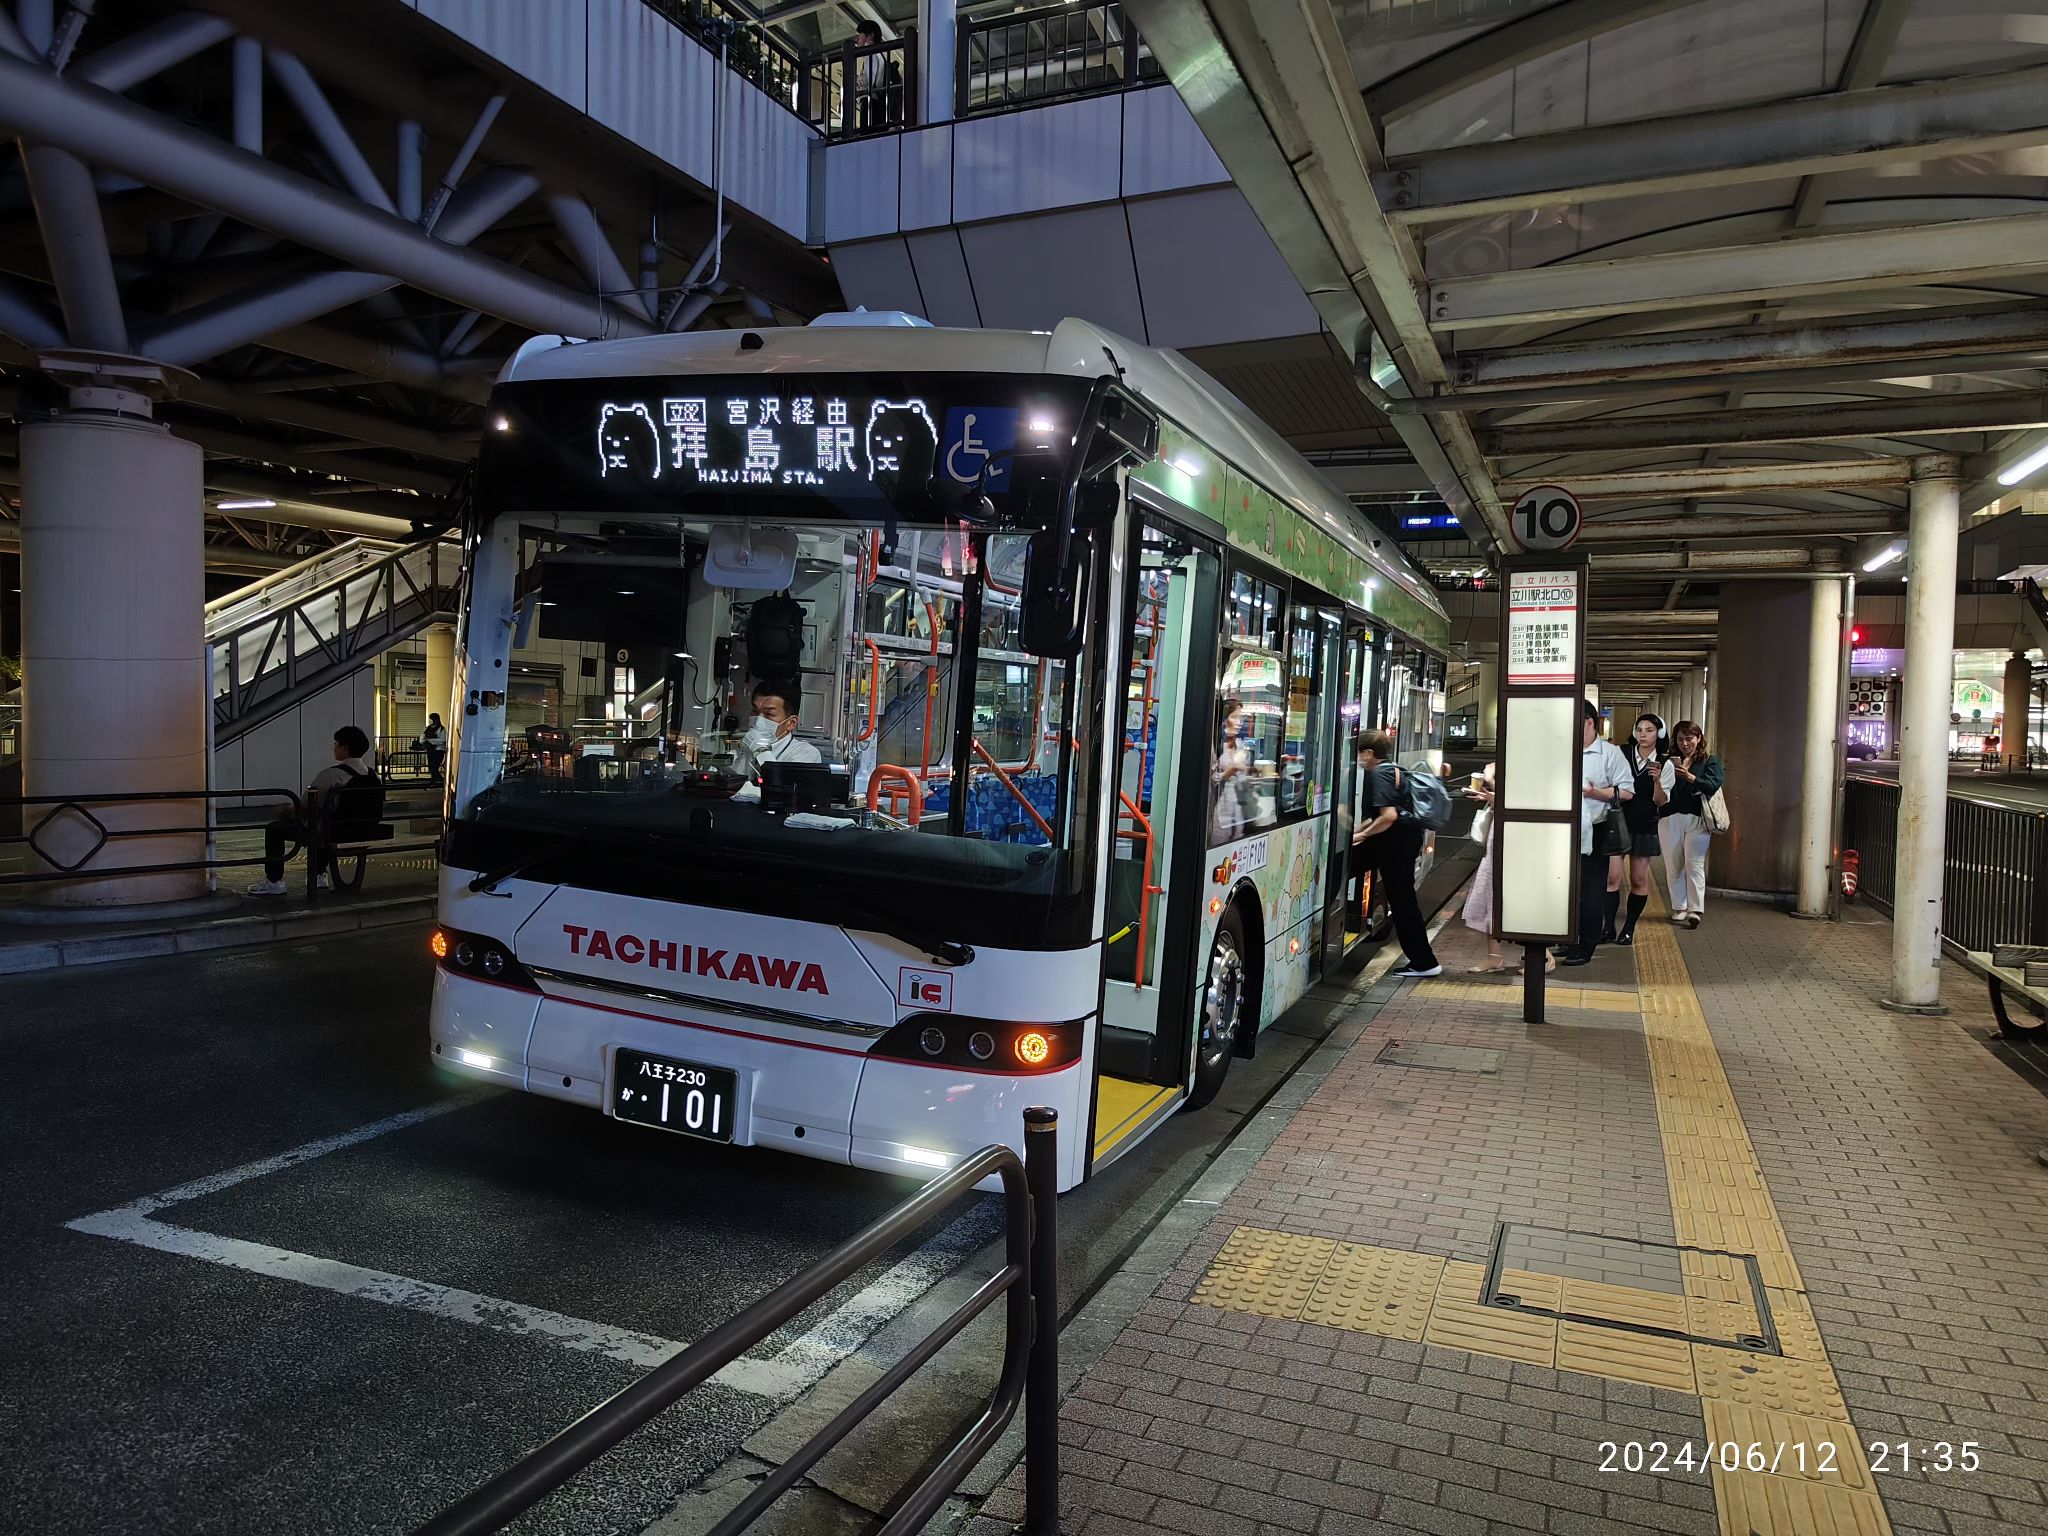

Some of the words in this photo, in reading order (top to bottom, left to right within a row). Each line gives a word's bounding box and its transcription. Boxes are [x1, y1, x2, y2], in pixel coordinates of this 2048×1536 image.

[727, 398, 848, 425] 宮沢経由
[670, 424, 858, 472] 拝島駅
[698, 469, 774, 485] HAIJIMA
[783, 470, 824, 485] STA.
[1516, 498, 1577, 539] 10
[1527, 576, 1570, 585] 立川バス
[1249, 840, 1266, 867] F101
[563, 924, 830, 996] TACHIKAWA
[621, 1087, 634, 1101] か
